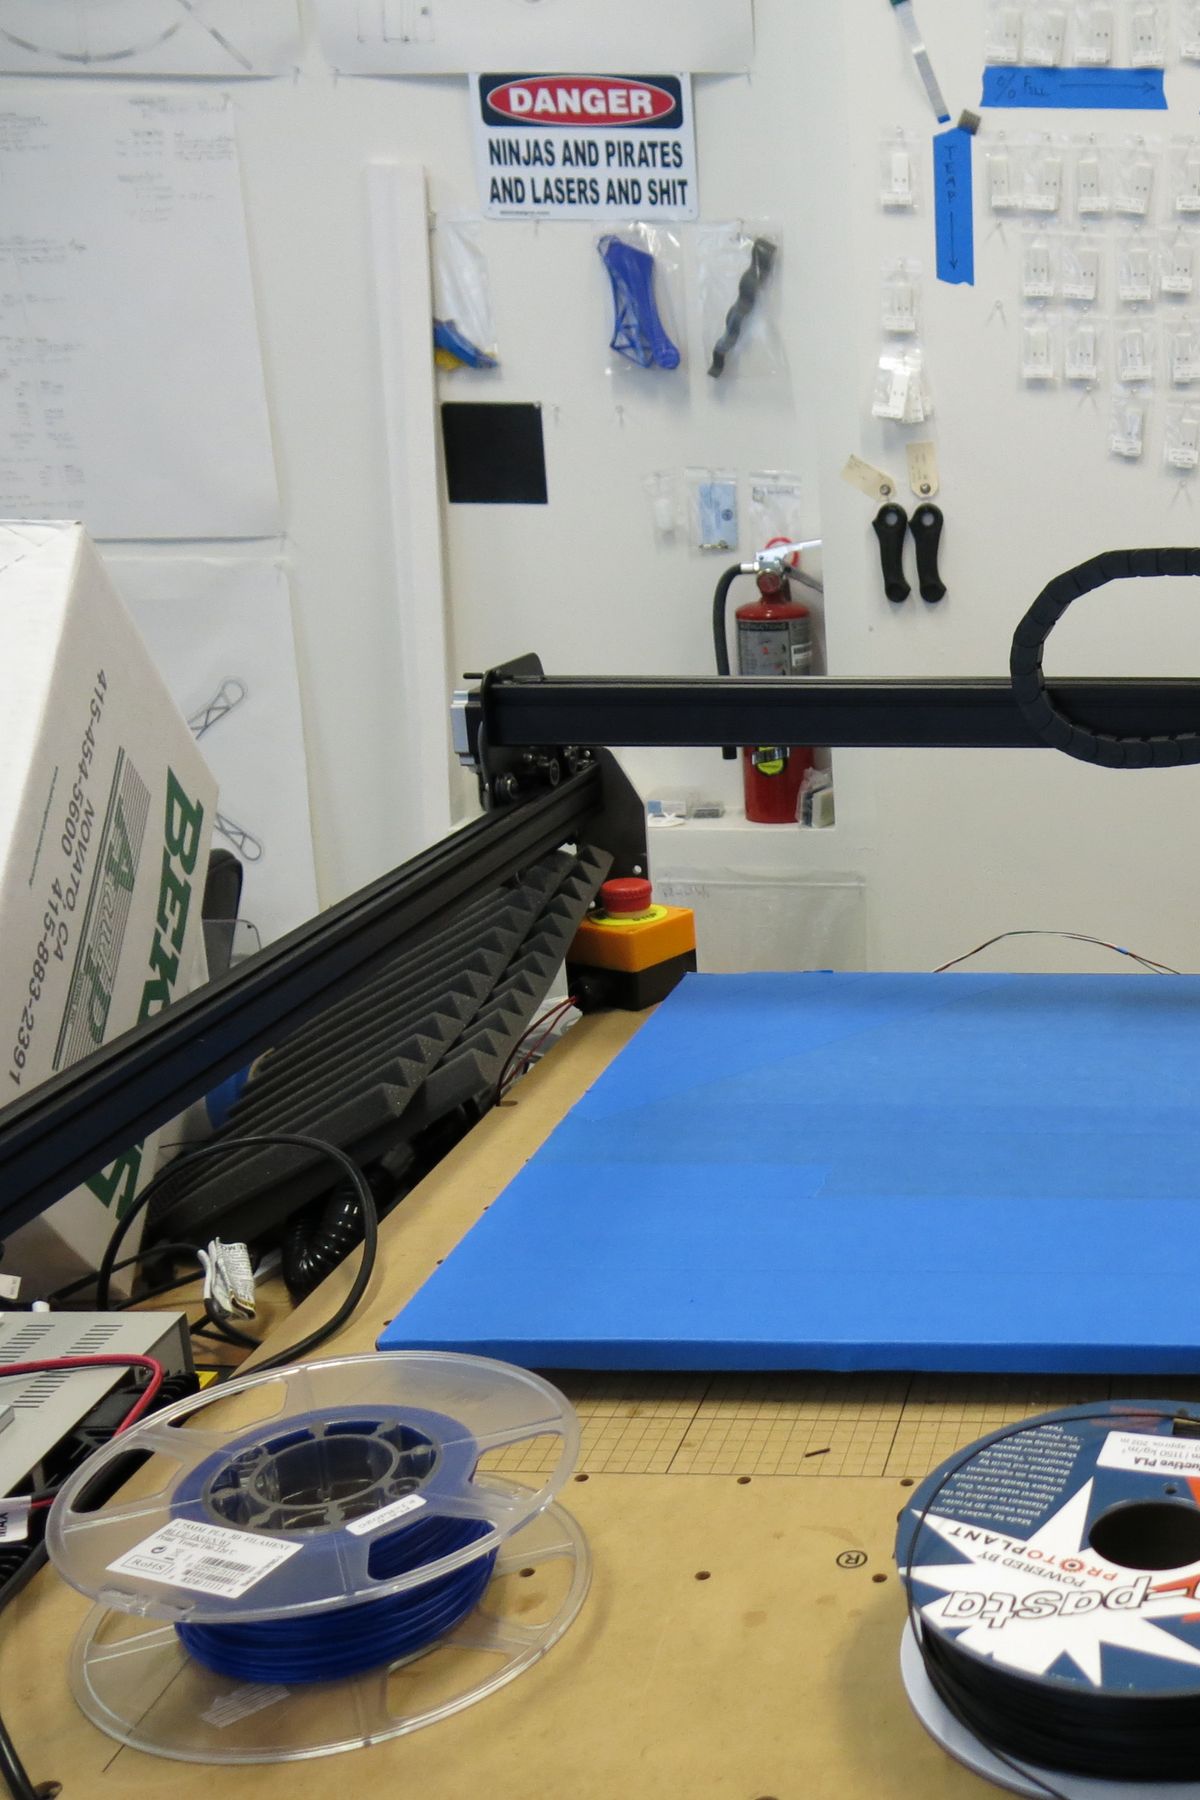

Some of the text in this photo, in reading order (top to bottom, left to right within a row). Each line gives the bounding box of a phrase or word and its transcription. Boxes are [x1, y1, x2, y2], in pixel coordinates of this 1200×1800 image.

[509, 87, 653, 115] DANGER
[488, 138, 683, 169] NINJAS AND PIRATES
[490, 176, 688, 206] AND LASERS AND SHIT
[61, 669, 108, 857] 415-454-5600
[53, 799, 95, 962] NOVATO, CA
[8, 877, 68, 1087] 415-883-2391
[1013, 1436, 1032, 1444] with
[1061, 1433, 1078, 1443] The
[1033, 1439, 1066, 1449] making
[1022, 1446, 1042, 1454] your
[1043, 1448, 1076, 1459] sharing
[991, 1451, 1024, 1460] Thanks
[1134, 1455, 1156, 1466] PLA
[990, 1458, 1011, 1466] built
[1011, 1461, 1029, 1469] and
[966, 1464, 1013, 1476] equipment
[1029, 1464, 1070, 1475] designed
[999, 1478, 1030, 1487] blends
[1027, 1473, 1066, 1483] in-house
[955, 1481, 974, 1489] Our
[1031, 1483, 1062, 1492] unique
[964, 1491, 998, 1502] crafted
[1020, 1490, 1054, 1500] highest
[974, 1501, 985, 1509] 3D
[1007, 1497, 1048, 1509] Filament
[988, 1504, 1015, 1513] exotic
[1016, 1508, 1040, 1516] pasta
[1006, 1516, 1031, 1525] Made
[244, 1535, 291, 1552] FILAMENT
[948, 1525, 1119, 1583] PROTOPLANT
[978, 1550, 1087, 1588] POWERED BY
